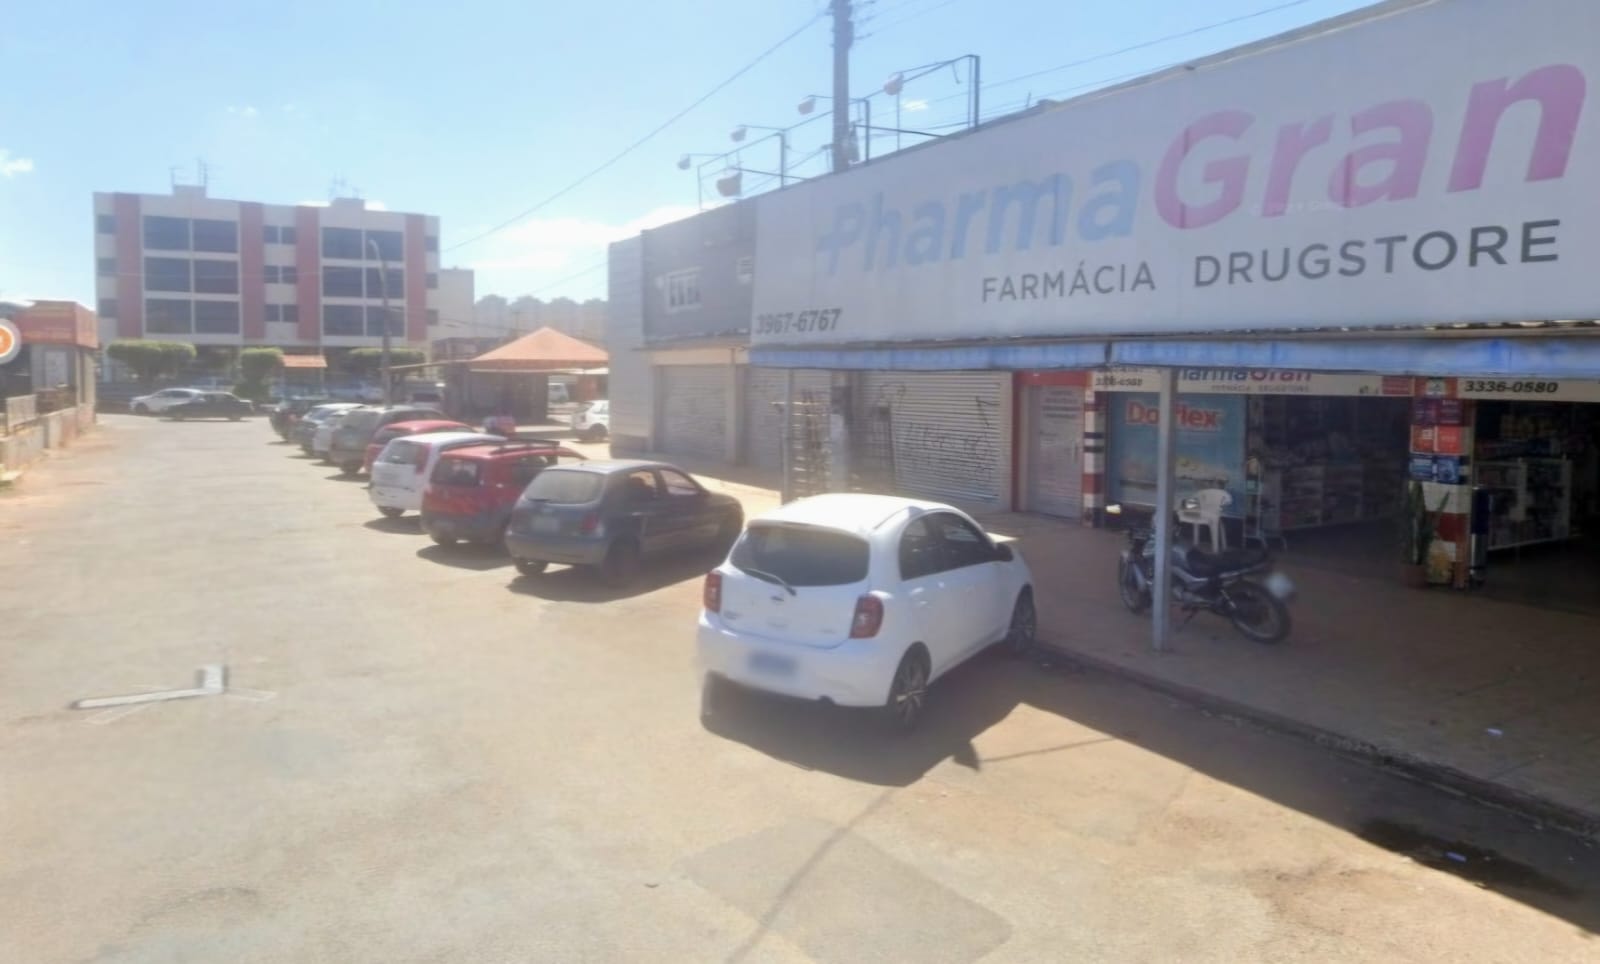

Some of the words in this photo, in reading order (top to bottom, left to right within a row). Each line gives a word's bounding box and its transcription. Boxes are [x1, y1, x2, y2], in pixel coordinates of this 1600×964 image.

[817, 63, 1587, 276] PharmaGran
[981, 259, 1156, 303] FARMÁCIA
[1194, 218, 1561, 288] DRUGSTORE
[755, 308, 843, 335] 3967-6767
[1464, 380, 1559, 394] 3336-0580
